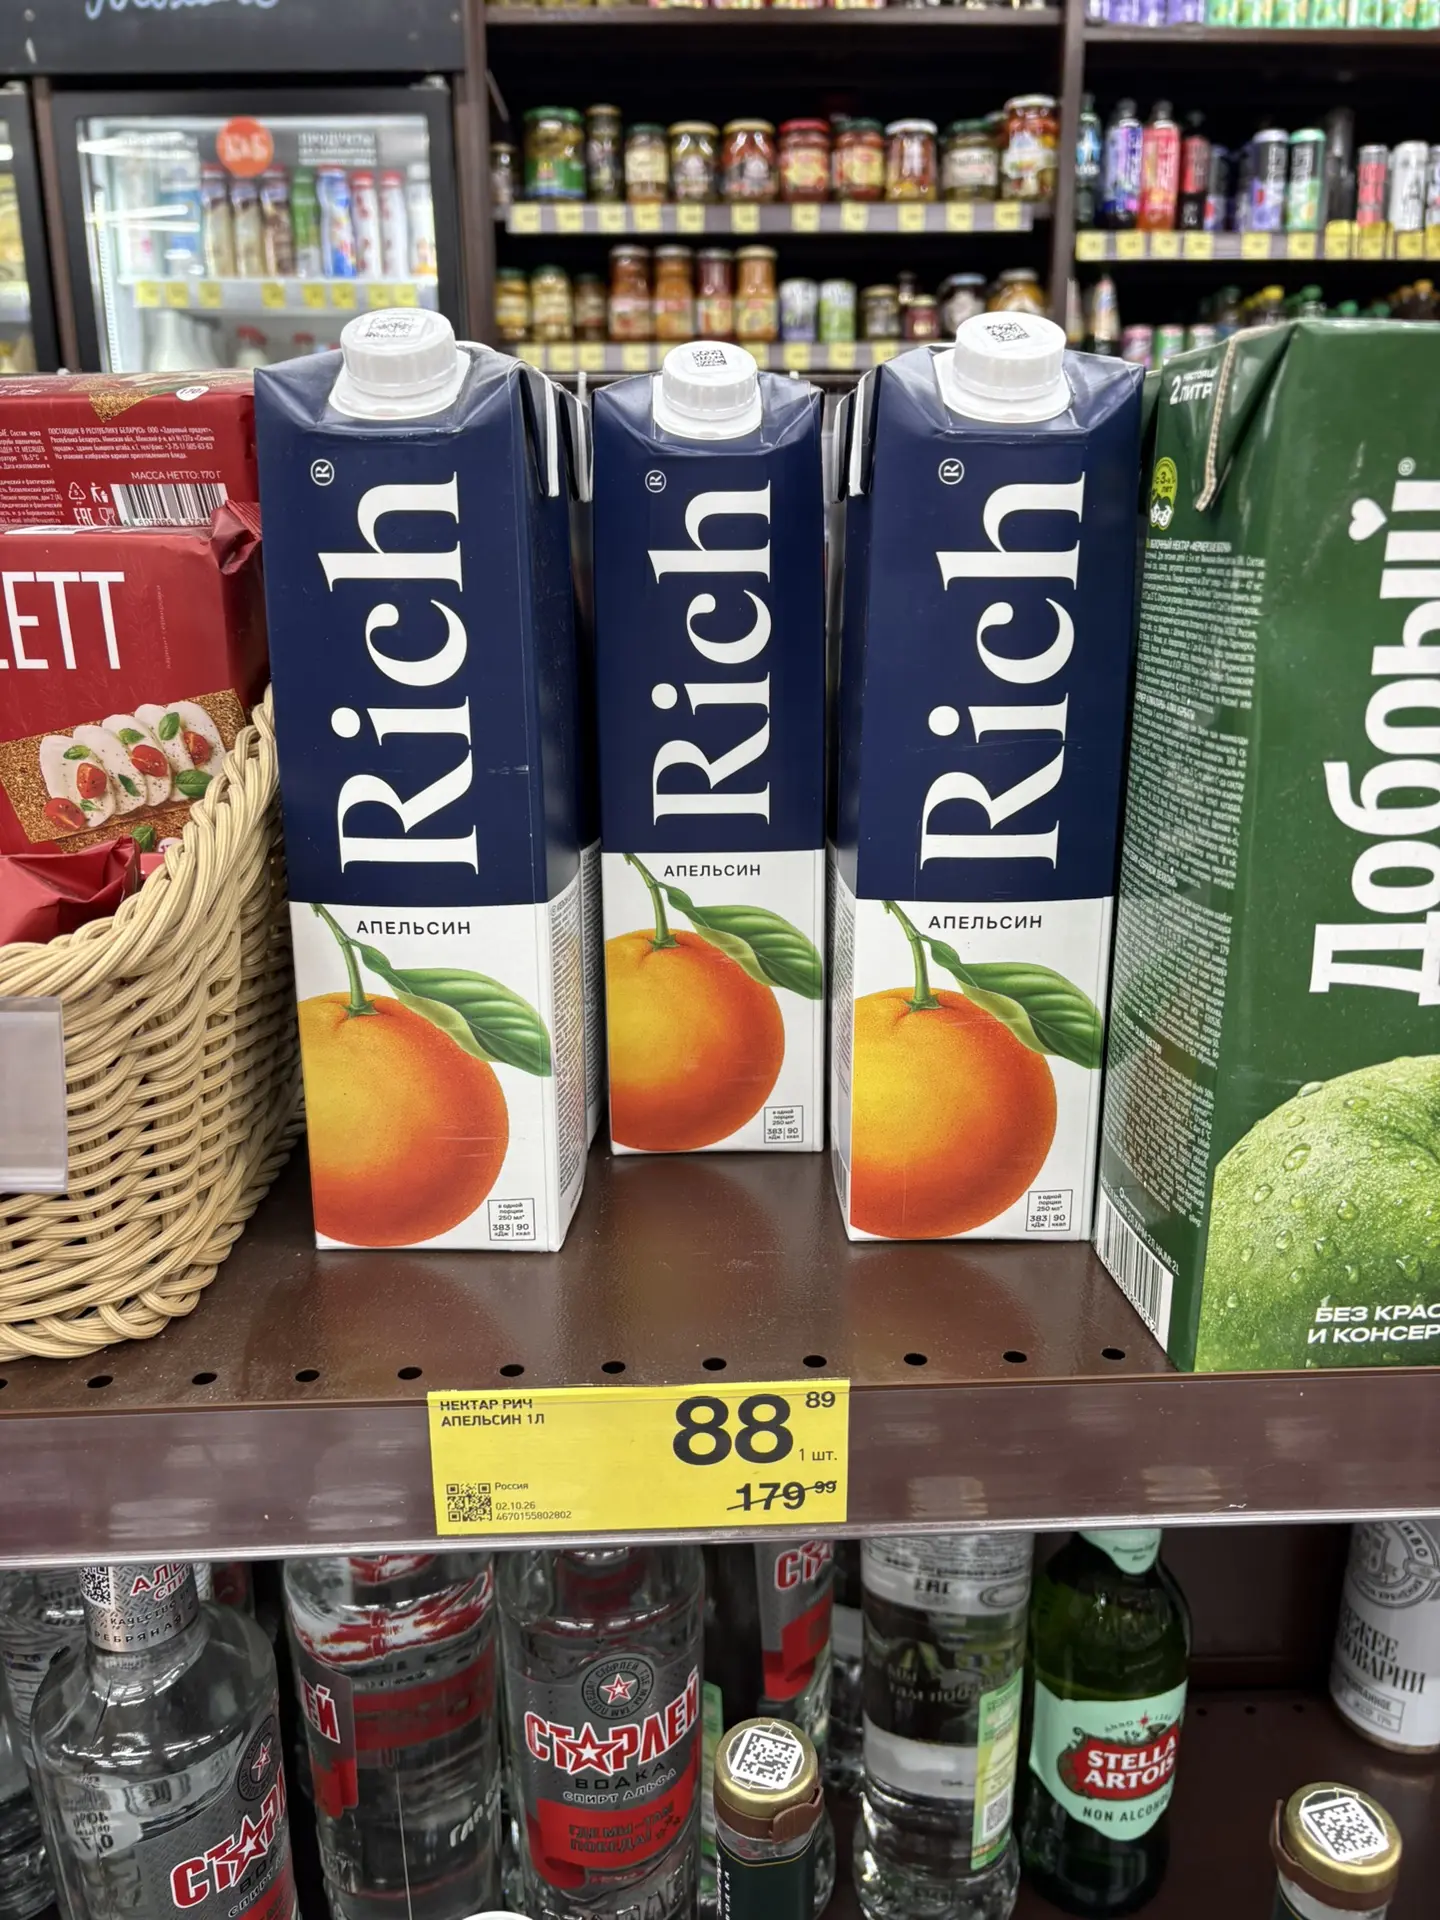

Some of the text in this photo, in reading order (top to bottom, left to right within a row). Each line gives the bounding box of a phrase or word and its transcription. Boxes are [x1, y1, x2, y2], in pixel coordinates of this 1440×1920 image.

[1170, 375, 1181, 405] 2
[131, 471, 166, 480] МАССА
[167, 471, 200, 479] НЕТТО:
[200, 470, 215, 479] 170
[0, 571, 125, 670] ETT
[648, 479, 772, 826] Rich
[318, 471, 479, 875] Rich
[920, 471, 1086, 870] Rich
[664, 864, 761, 877] АПЕЛЬСИН
[356, 920, 471, 936] АПЕЛЬСИН
[928, 915, 1043, 930] АПЕЛЬСИН
[1030, 1214, 1048, 1222] 383
[492, 1223, 530, 1231] 383 90
[1315, 1306, 1369, 1323] БЕЗ
[1307, 1328, 1328, 1344] И
[440, 1398, 533, 1411] НЕКТАР РИЧ
[441, 1414, 521, 1427] АПЕЛЬСИН
[672, 1391, 836, 1466] 88 89
[799, 1448, 838, 1461] 1 шт.
[495, 1482, 529, 1491] Россия
[735, 1480, 837, 1512] 179 99
[495, 1501, 536, 1511] 02.10.26
[496, 1510, 572, 1521] 4670155802802
[1087, 1735, 1177, 1771] STELLA
[575, 1761, 666, 1790] ВОДКА
[1083, 1756, 1176, 1790] ARTOIS
[563, 1767, 678, 1805] СПИРТ АЛЬФА
[1082, 1806, 1114, 1823] NON
